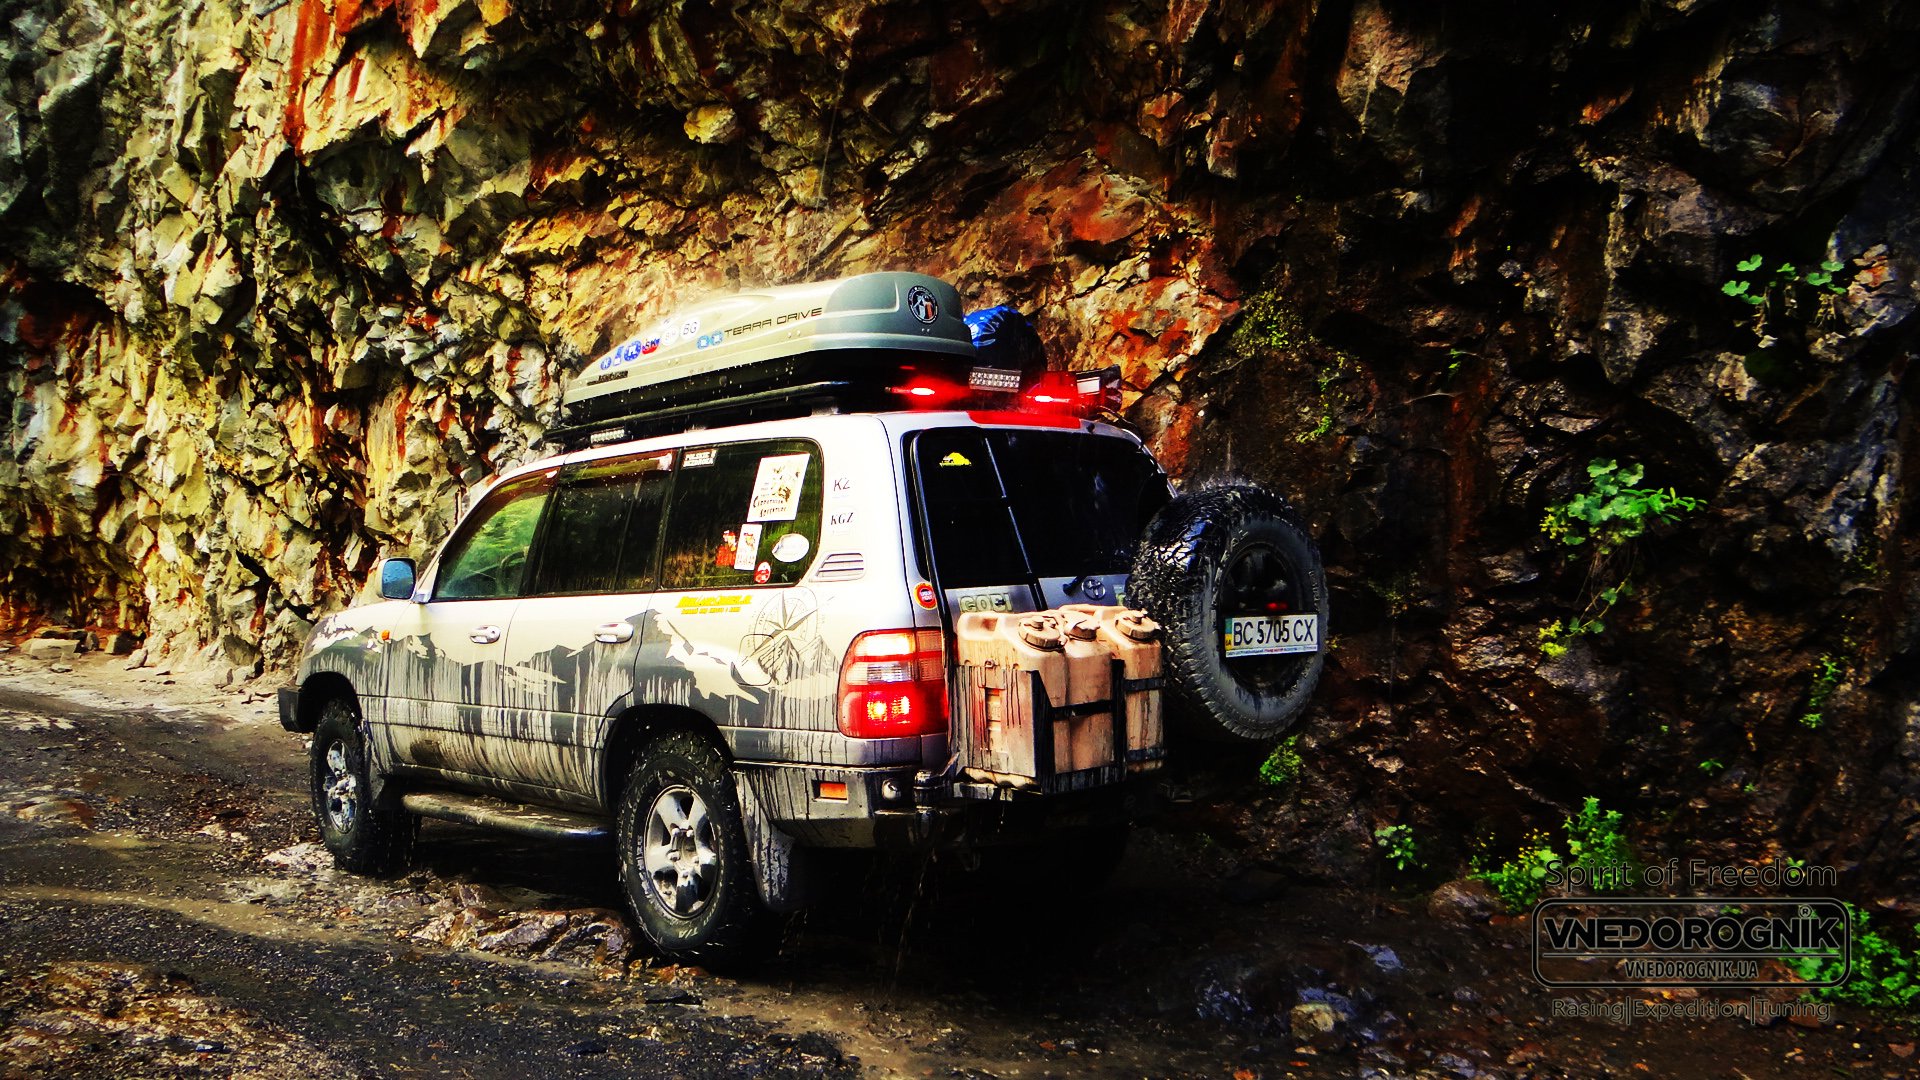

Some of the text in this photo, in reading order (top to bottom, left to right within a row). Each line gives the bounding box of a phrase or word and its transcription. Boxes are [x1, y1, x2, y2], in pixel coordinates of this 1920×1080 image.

[683, 321, 698, 335] BG
[724, 307, 823, 338] TERRA DRIVE
[830, 512, 854, 526] KGZ
[1233, 618, 1315, 646] BC 5705 CX
